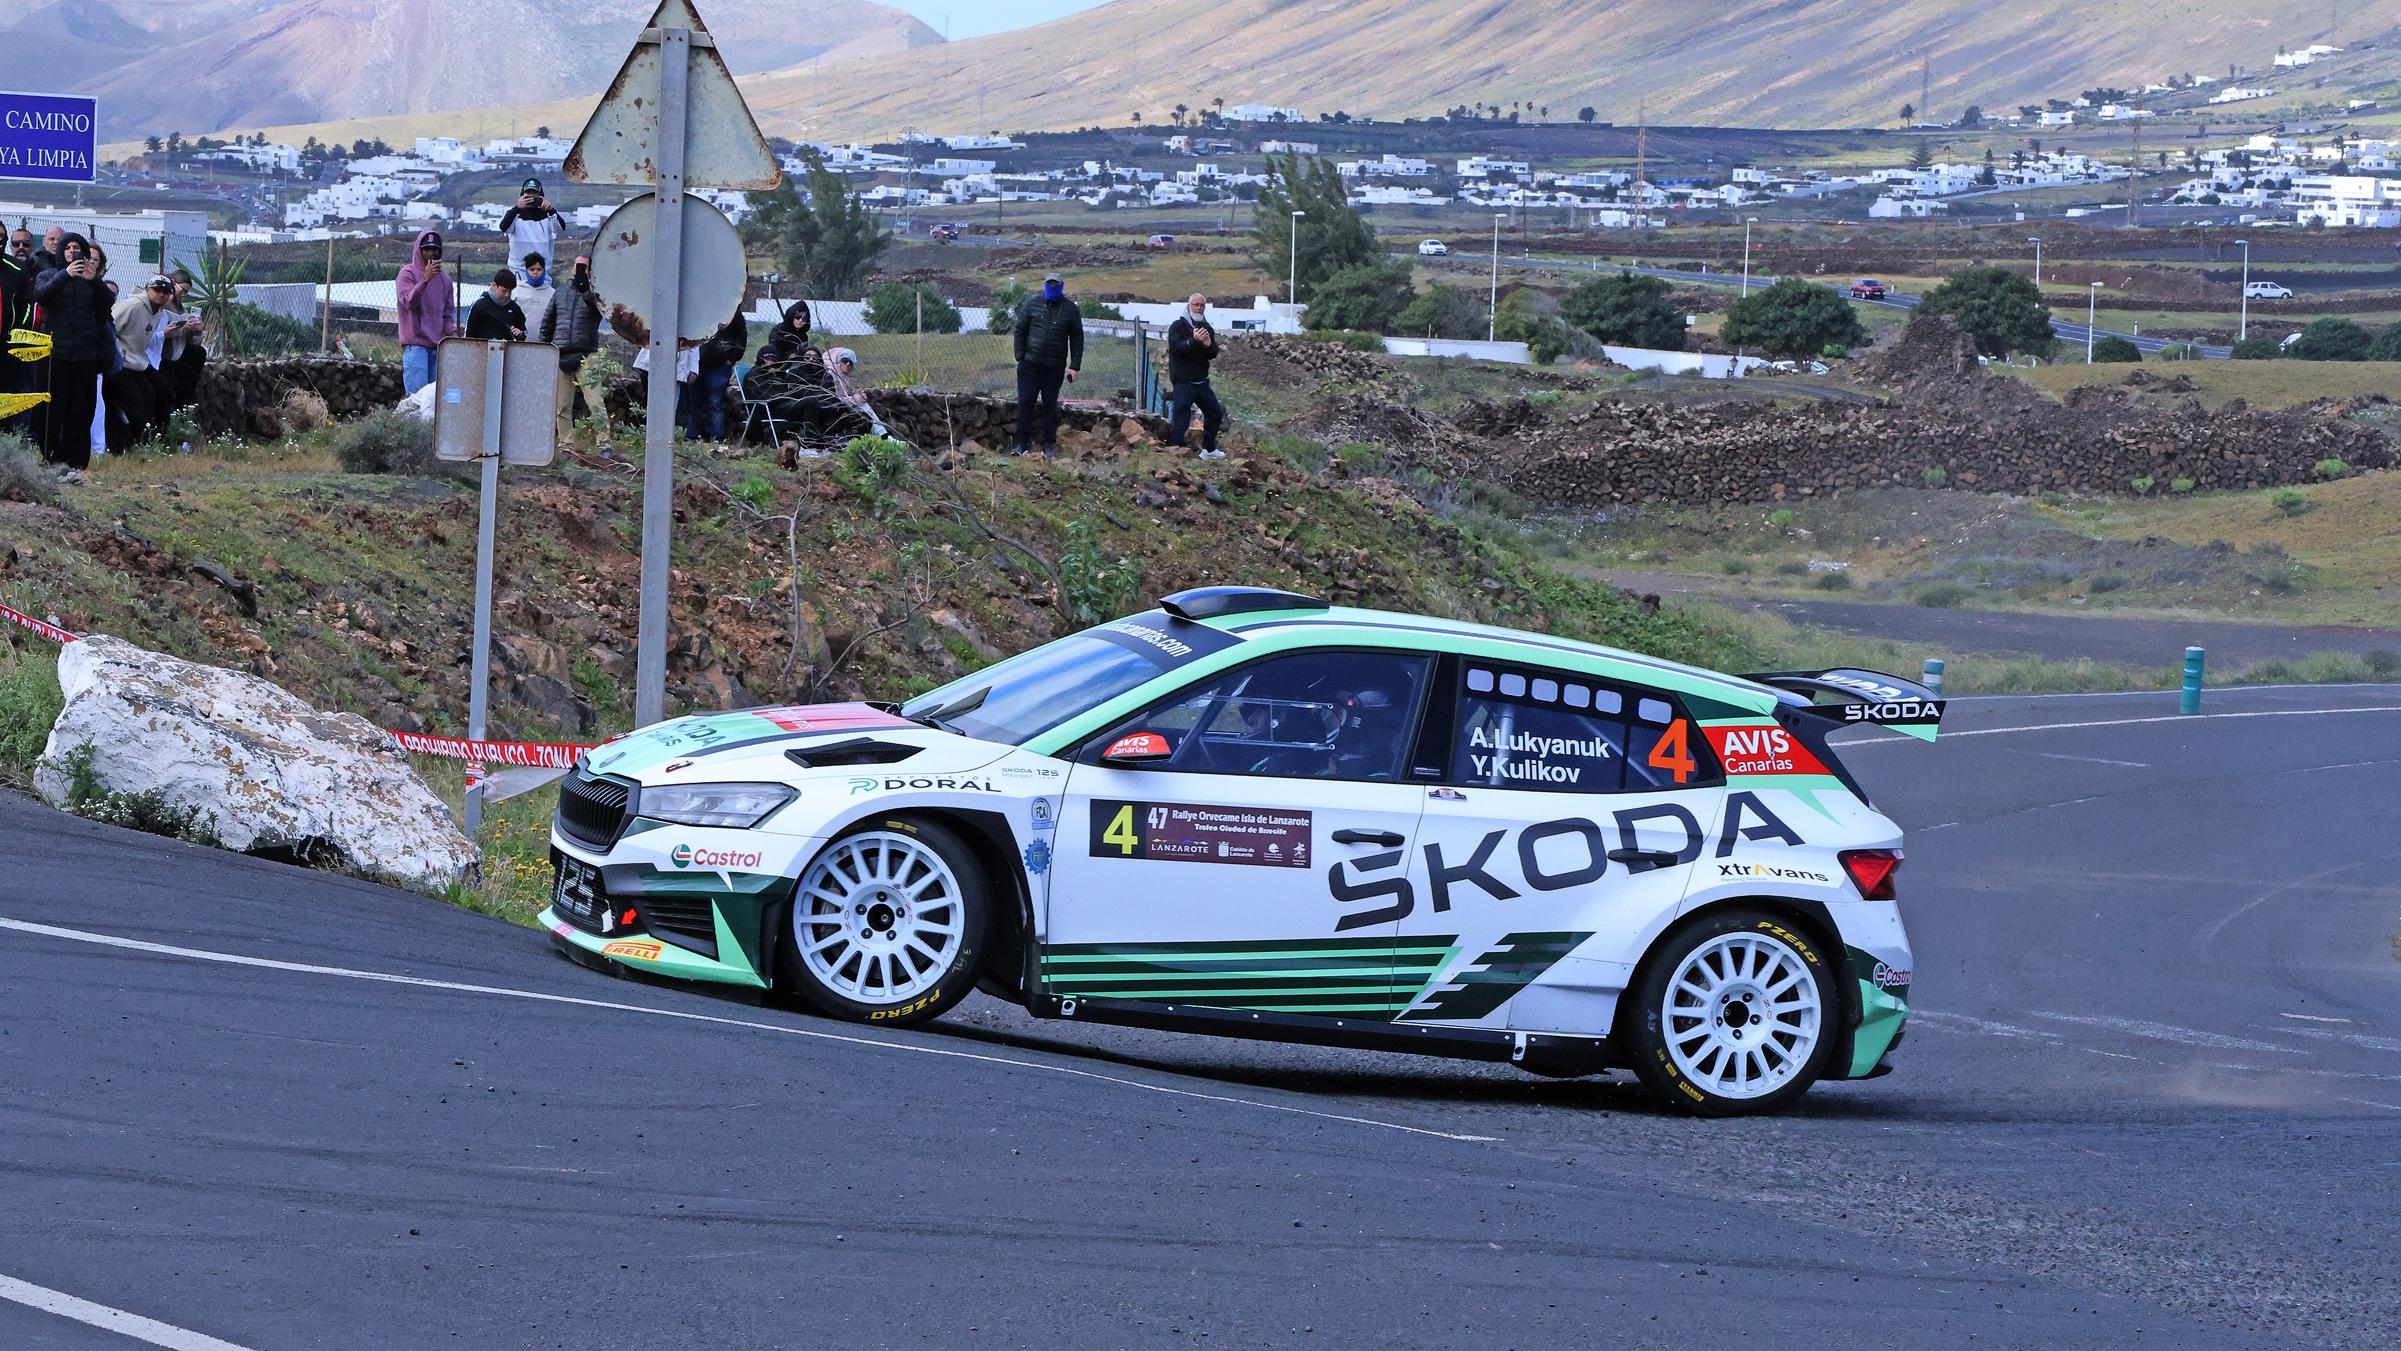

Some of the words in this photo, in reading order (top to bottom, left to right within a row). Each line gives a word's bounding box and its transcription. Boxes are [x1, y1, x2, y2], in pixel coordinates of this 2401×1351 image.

[5, 110, 90, 133] CAMINO
[26, 148, 88, 169] LIMPIA
[1470, 727, 1610, 758] A.Lukyanuk
[1648, 718, 1695, 784] 4
[1724, 728, 1790, 756] AVIS
[1470, 754, 1581, 783] Y.Kulikov
[1724, 758, 1793, 773] Canarias
[885, 778, 1002, 793] DORAL
[1102, 804, 1139, 854] 4
[1147, 807, 1169, 830] 47
[1172, 809, 1198, 822] Rallye
[1199, 811, 1240, 822] Orvecame
[1241, 814, 1256, 823] Isla
[1257, 815, 1267, 824] de
[1268, 815, 1310, 827] Lanzarote
[1194, 823, 1218, 832] Trofeo
[1248, 826, 1257, 834] de
[693, 847, 762, 868] Castrol
[1151, 843, 1209, 854] LANZAROTE
